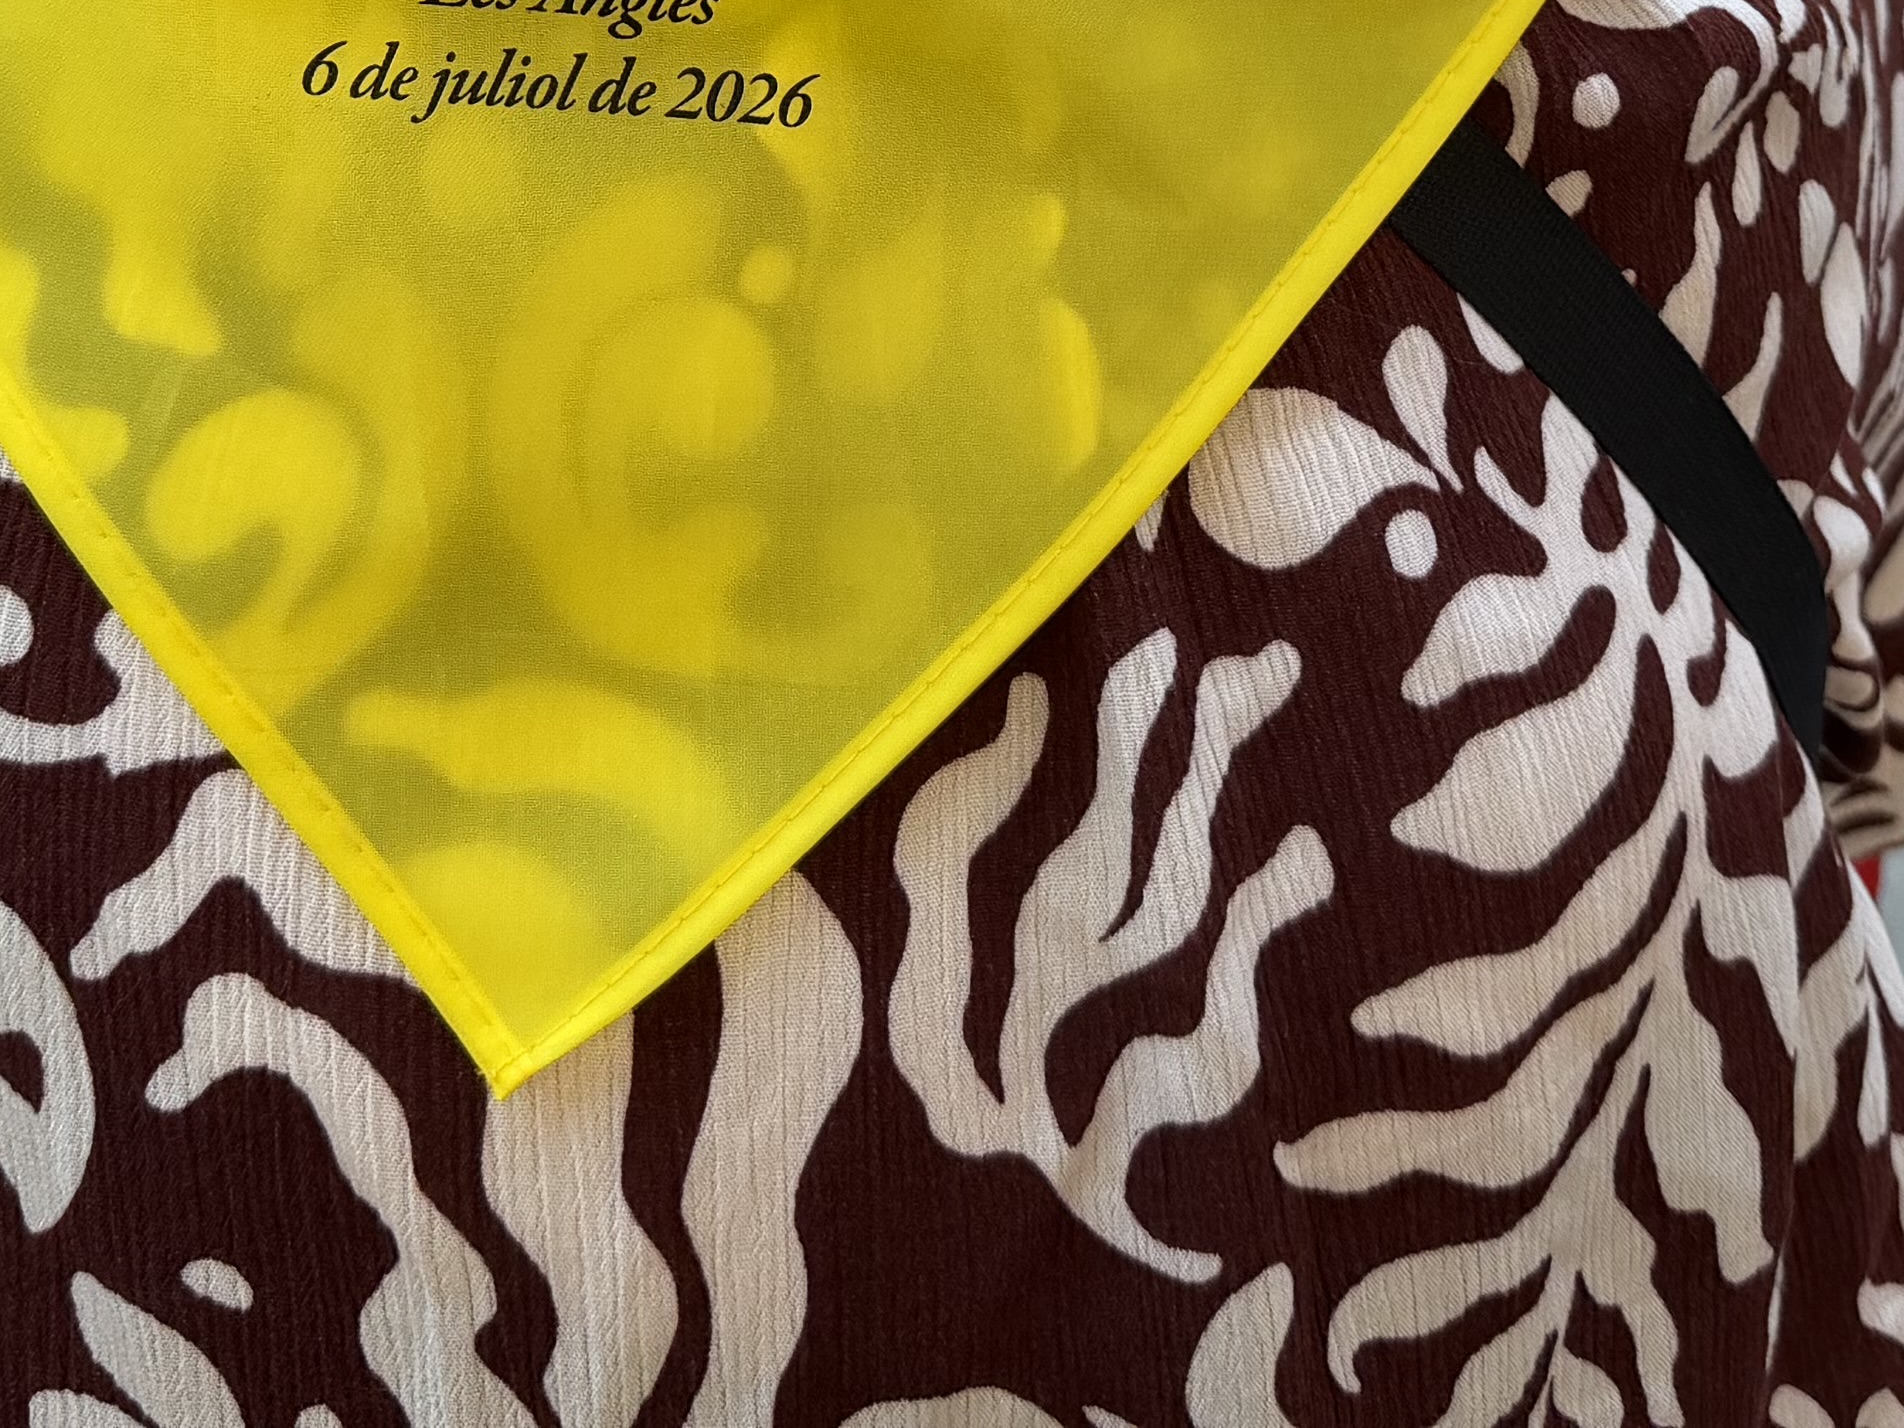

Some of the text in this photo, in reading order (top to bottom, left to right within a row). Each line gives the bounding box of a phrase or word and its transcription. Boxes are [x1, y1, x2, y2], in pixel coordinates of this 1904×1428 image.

[301, 40, 822, 129] 6 de juliol de 2026
